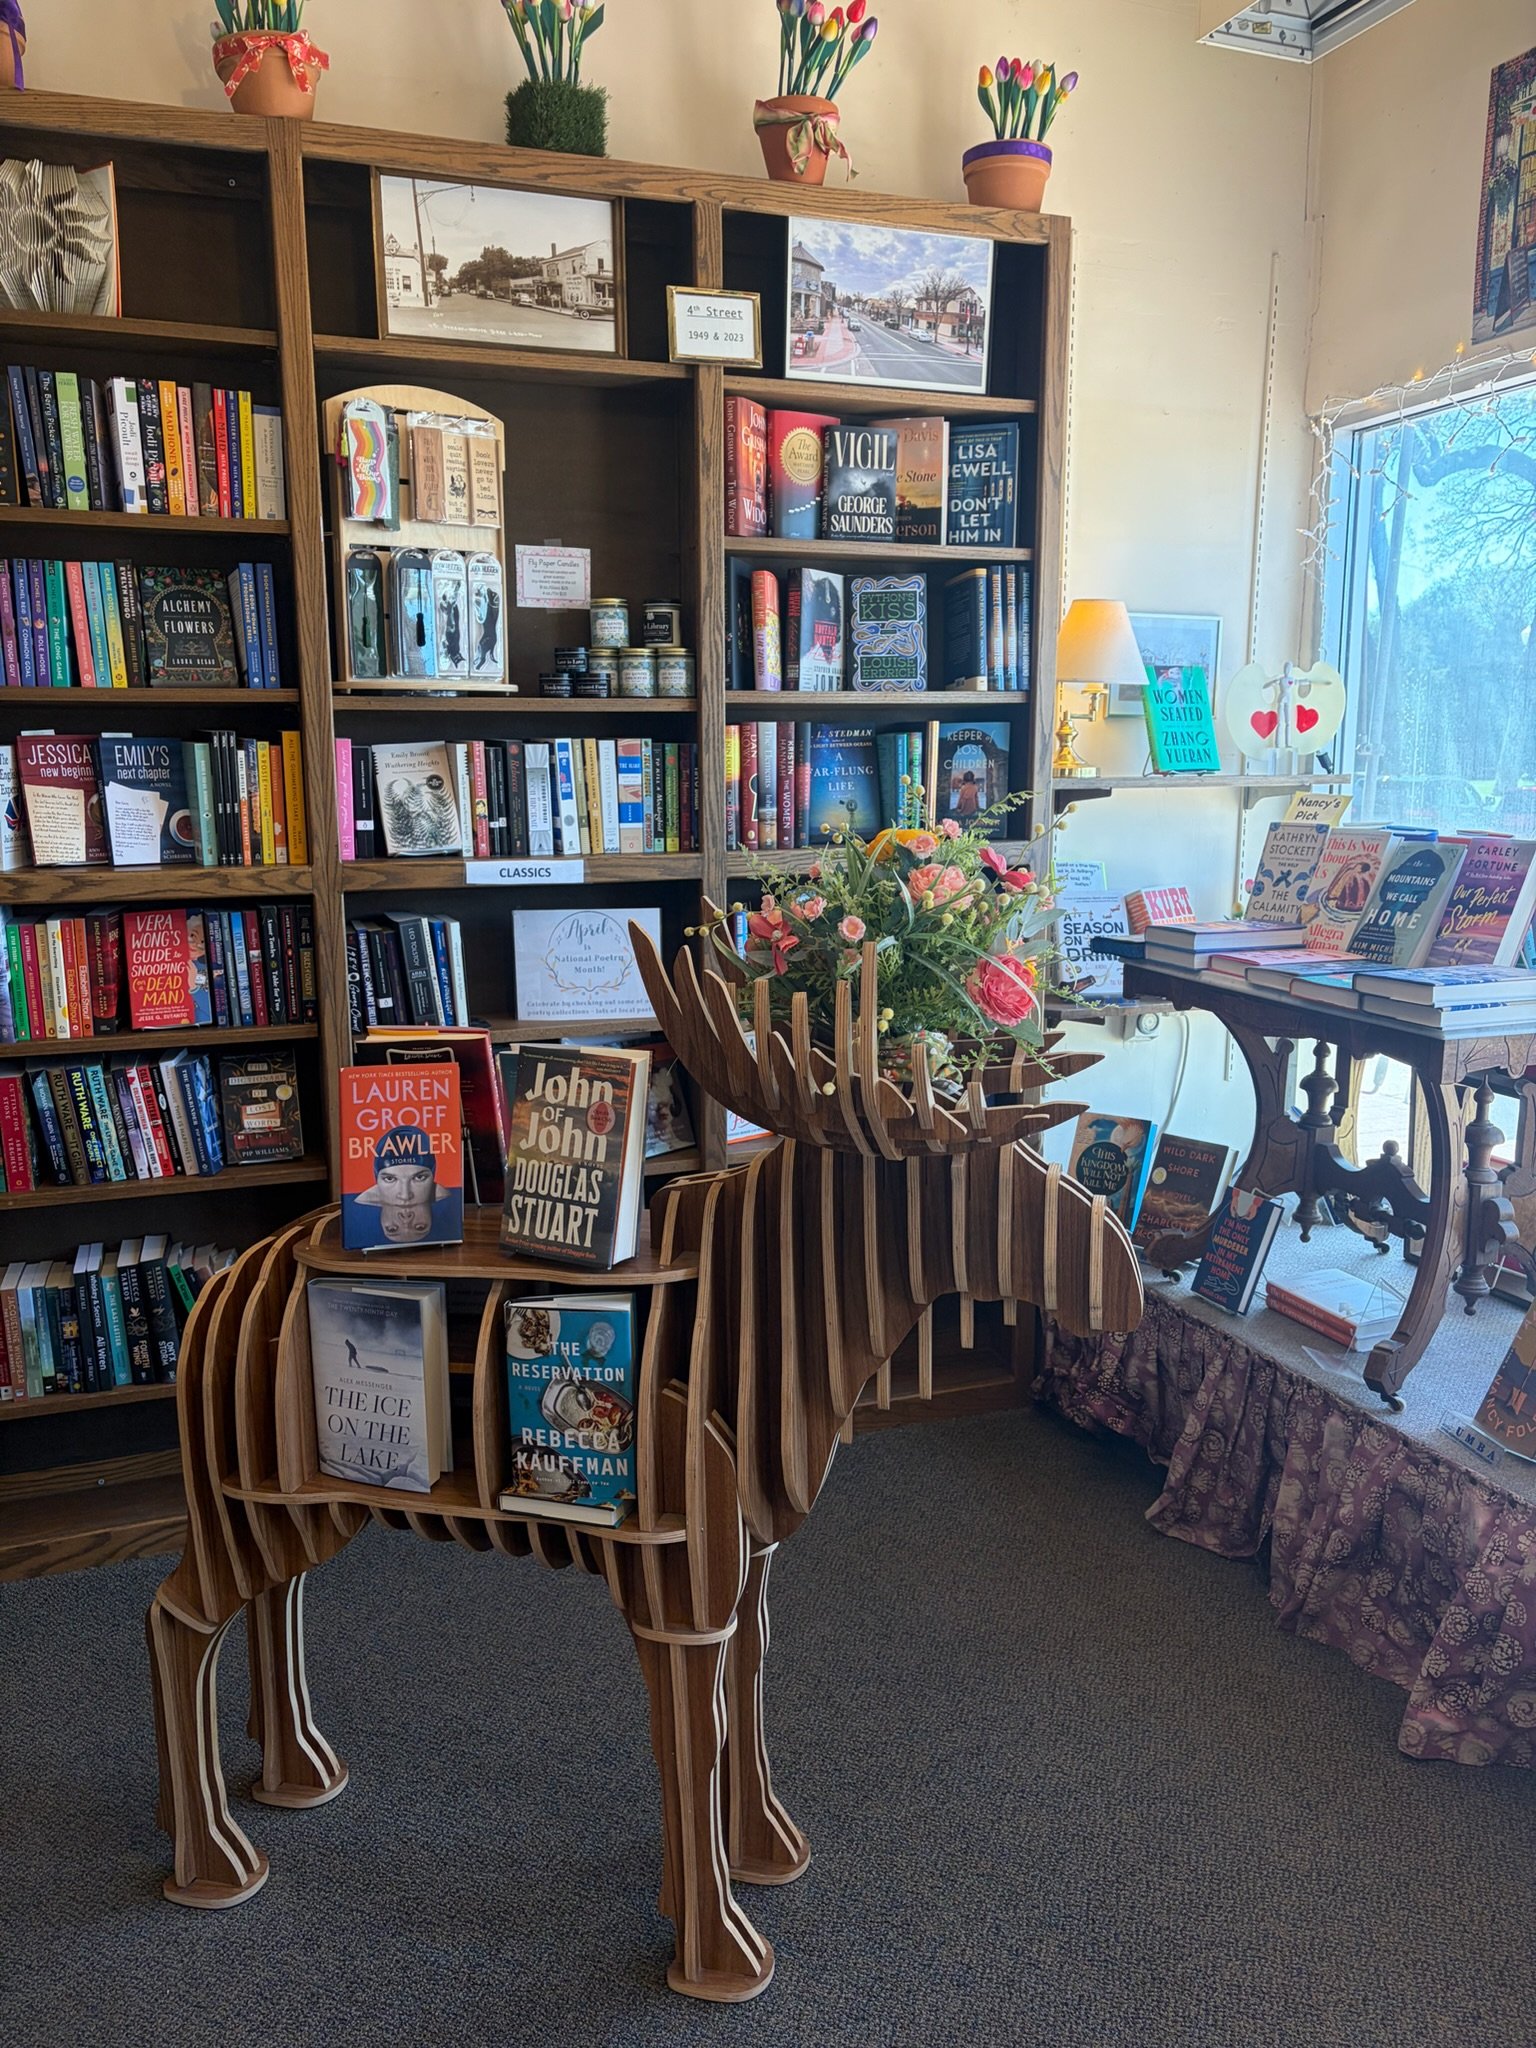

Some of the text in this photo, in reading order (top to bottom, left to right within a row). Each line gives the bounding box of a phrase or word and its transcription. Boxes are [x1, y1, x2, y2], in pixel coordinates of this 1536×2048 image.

[706, 306, 743, 318] Street
[688, 331, 744, 342] 1949 & 2023
[42, 377, 56, 447] The Berry Pickers
[120, 412, 132, 446] Picoult
[129, 421, 137, 438] Jodi
[903, 427, 940, 443] Davis
[797, 439, 812, 450] The
[834, 431, 895, 470] VIGIL
[957, 443, 998, 460] LISA
[146, 424, 161, 488] Jodi Picoult
[788, 451, 819, 462] Award
[904, 469, 938, 483] Stone
[951, 461, 1012, 478] EWELL
[838, 495, 888, 515] GEORGE
[951, 497, 1001, 512] DON'T
[830, 514, 894, 535] SAUNDERS
[960, 513, 992, 527] LET
[950, 528, 1002, 544] HIM IN
[528, 558, 580, 569] Fly Paper Candles
[162, 599, 212, 613] ALCHEMY
[861, 593, 916, 603] PYTHON'S
[123, 595, 131, 618] HUGO
[860, 602, 916, 619] KISS
[164, 620, 215, 634] FLOWERS
[862, 656, 916, 669] LOUISE
[862, 668, 917, 679] ERDRICH
[1153, 689, 1207, 706] WOMEN,
[1160, 706, 1203, 722] SEATED
[828, 729, 873, 738] STEDMAN
[946, 729, 996, 743] KEEPER of
[1162, 731, 1211, 746] ZHANG
[27, 743, 94, 765] JESSICA'
[114, 744, 170, 767] EMILY'S
[786, 740, 795, 775] KRISTIN
[834, 752, 843, 761] A
[956, 744, 984, 755] LOST
[1165, 748, 1213, 764] YUERAN
[40, 767, 59, 778] new
[384, 760, 440, 769] Wuthering Heights
[943, 759, 995, 770] CHILDREN
[117, 767, 171, 782] next chapter
[828, 782, 855, 791] LIFE
[782, 791, 791, 829] WOMEN
[1297, 796, 1342, 810] Nancy's
[1294, 811, 1320, 821] Pick
[1272, 832, 1319, 844] KATHRYN
[1327, 837, 1381, 854] This Is Not
[1269, 844, 1316, 856] STOCKETT
[1477, 845, 1520, 857] CARLEY
[499, 868, 552, 878] CLASSICS
[1467, 859, 1519, 873] FORTUNE
[1387, 874, 1437, 887] MOUNTAINS
[1144, 886, 1194, 921] KURT
[1271, 890, 1290, 901] THE
[1386, 891, 1419, 904] WE CALL
[1453, 884, 1516, 909] Our Perfect
[1252, 901, 1300, 913] CALAMITY
[136, 914, 173, 932] VERA
[1063, 914, 1073, 922] A
[1364, 908, 1422, 930] HOME
[1442, 905, 1498, 937] Storm
[566, 918, 609, 945] April
[1063, 922, 1125, 935] SEASON
[1307, 924, 1345, 941] Allegra
[131, 931, 181, 948] WONG'S
[1064, 936, 1082, 946] ON
[132, 948, 173, 964] GUIDE
[411, 941, 420, 966] TOLSTOY
[555, 954, 624, 964] National Poetry
[131, 961, 187, 978] SNOOPING
[574, 965, 605, 974] Month!
[146, 976, 183, 991] DEAD
[142, 989, 186, 1006] MAN)
[248, 1062, 268, 1071] THE
[395, 1070, 430, 1078] BESTSELLING
[229, 1073, 286, 1084] DICTIONARY
[524, 1062, 614, 1109] John
[90, 1070, 108, 1120] RUTH WARE
[253, 1090, 267, 1098] OF
[352, 1078, 450, 1104] LAUREN
[53, 1073, 74, 1130] RUTH WARE
[71, 1071, 93, 1130] RUTH WARE
[250, 1103, 274, 1114] LOST
[356, 1105, 448, 1131] GROFF
[542, 1106, 566, 1124] OF
[246, 1119, 280, 1128] WORDS
[348, 1132, 457, 1159] BRAWLER
[519, 1111, 609, 1164] John
[241, 1147, 290, 1158] PIP WILLIAMS
[1091, 1147, 1117, 1161] THIS
[1163, 1146, 1217, 1164] WILD DARK
[391, 1157, 417, 1165] STORIES
[1080, 1157, 1128, 1175] KINGDOM
[1082, 1167, 1123, 1181] WILL NOT
[1167, 1163, 1201, 1178] SHORE
[513, 1157, 604, 1206] DOUGLAS
[1082, 1178, 1117, 1190] KILL ME
[507, 1194, 599, 1249] STUART
[1235, 1220, 1251, 1233] NOT
[1218, 1225, 1250, 1243] THE ONLY
[1212, 1234, 1249, 1256] MURDERER
[1217, 1248, 1238, 1261] IN MY
[1204, 1252, 1246, 1276] RETIREMENT
[1209, 1266, 1231, 1281] HOME
[132, 1345, 142, 1366] WING
[139, 1340, 151, 1369] FOURTH
[158, 1341, 169, 1366] STORM
[166, 1341, 177, 1363] ONYX
[552, 1341, 581, 1357] THE
[97, 1348, 107, 1371] Wren
[512, 1362, 626, 1382] RESERVATION
[339, 1376, 394, 1392] ALEX MESSENGER
[325, 1386, 412, 1419] THE ICE
[327, 1414, 411, 1447] ON THE
[521, 1427, 621, 1450] REBECCA
[340, 1443, 400, 1473] LAKE
[516, 1451, 629, 1477] KAUFFMAN
